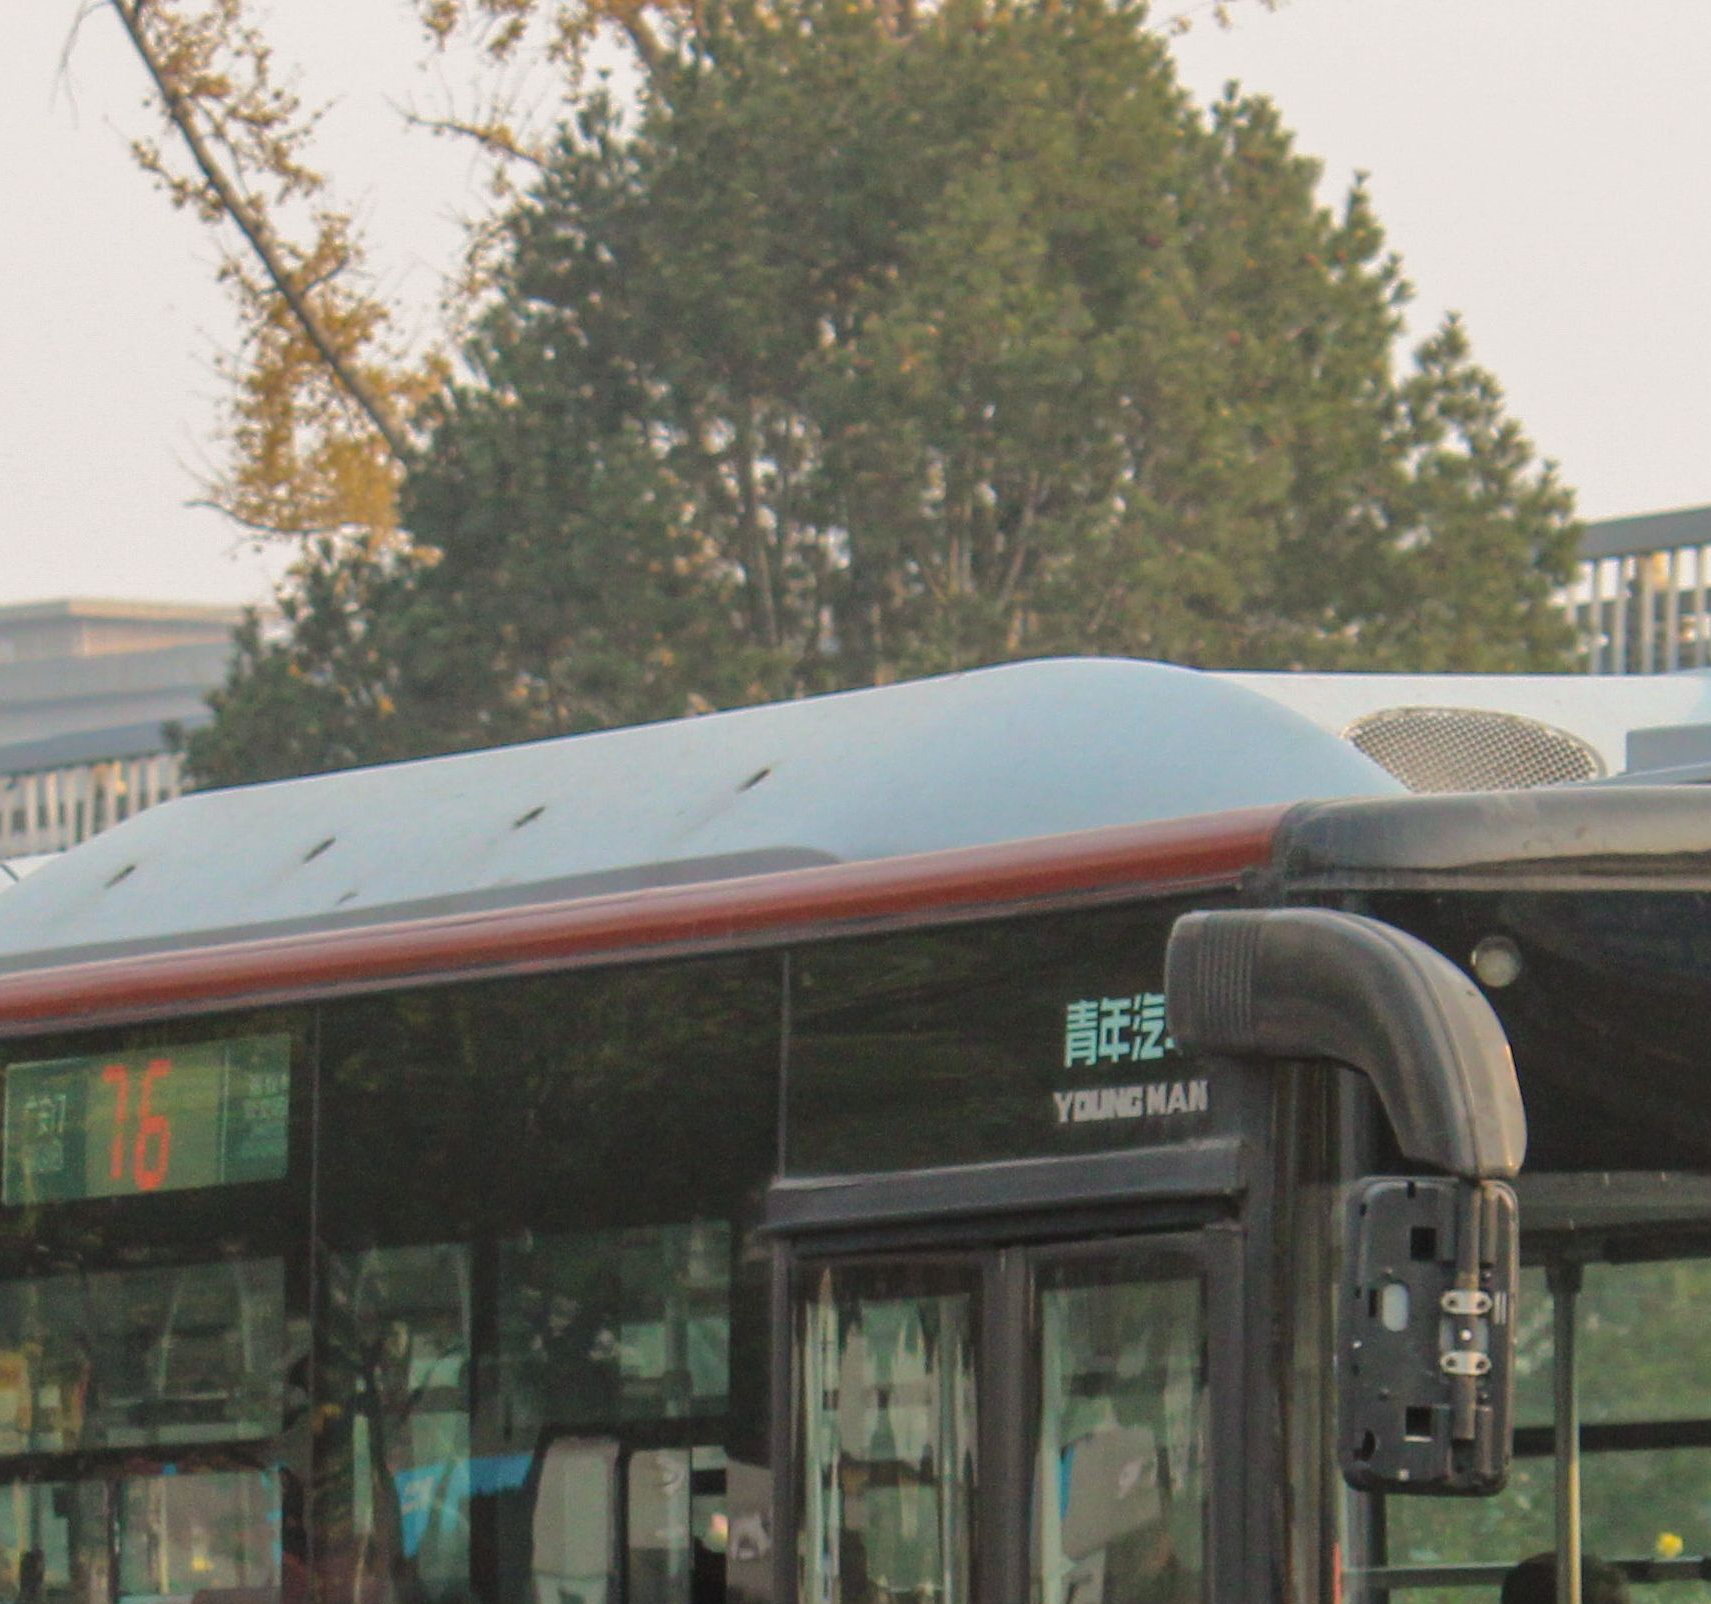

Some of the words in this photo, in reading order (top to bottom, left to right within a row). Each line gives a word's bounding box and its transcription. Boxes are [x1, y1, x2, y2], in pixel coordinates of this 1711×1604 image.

[1063, 992, 1177, 1068] 青年汽
[101, 1058, 172, 1191] 76
